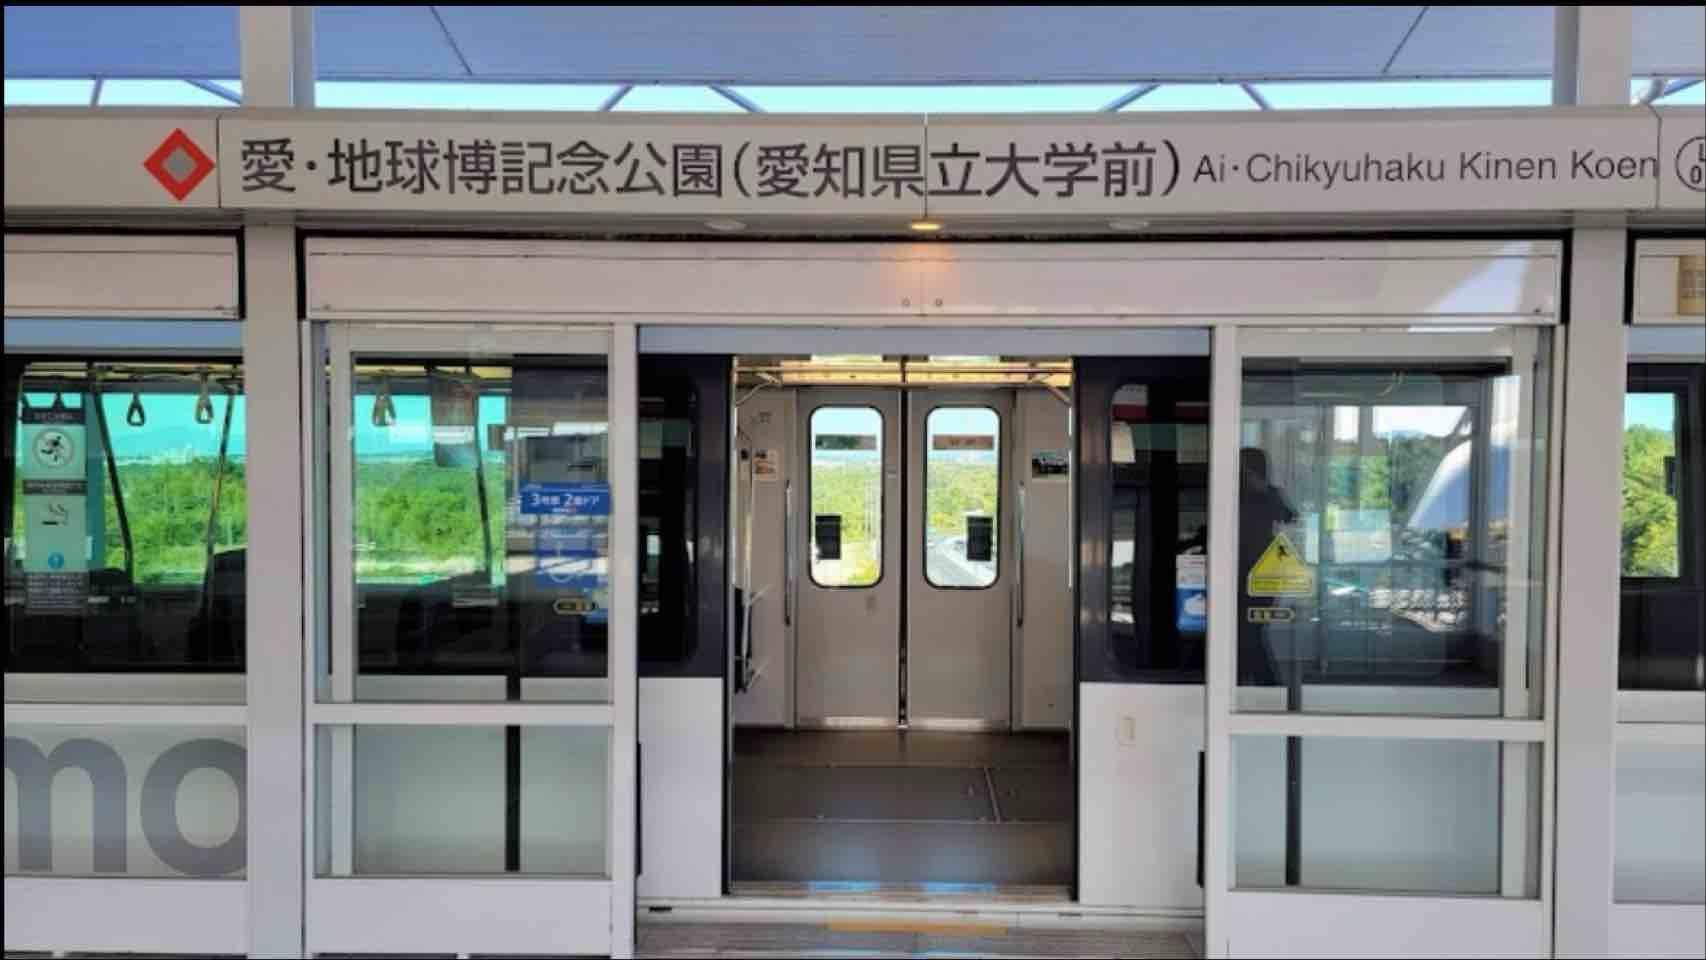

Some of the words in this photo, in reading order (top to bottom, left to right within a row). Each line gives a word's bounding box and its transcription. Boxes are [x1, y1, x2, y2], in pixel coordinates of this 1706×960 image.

[242, 138, 1180, 198] 愛・地球博記念公園（愛知県立大学前）
[1459, 151, 1556, 180] Kinen
[1571, 149, 1659, 179] Koen
